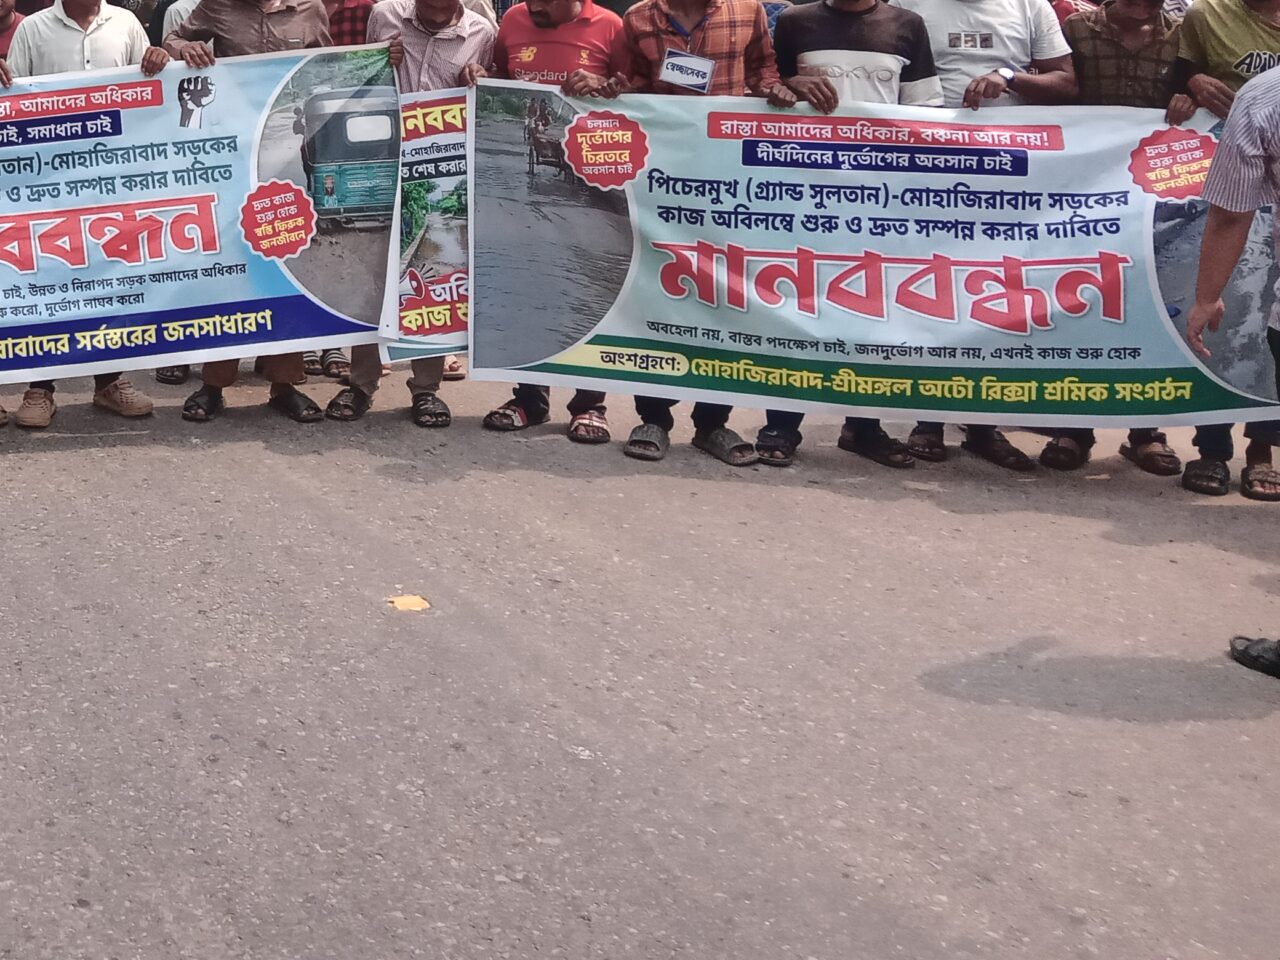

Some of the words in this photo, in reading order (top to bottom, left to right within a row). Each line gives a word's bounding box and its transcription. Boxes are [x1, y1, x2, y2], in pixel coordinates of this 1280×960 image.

[665, 62, 708, 81] স্বেচ্ছাসেবক
[721, 120, 758, 135] রাস্তা
[763, 123, 832, 139] আমাদের
[838, 121, 915, 142] অধিকার,
[922, 129, 970, 144] বঞ্চনা
[974, 131, 1010, 145] আর
[1015, 132, 1049, 147] নয়!
[412, 162, 435, 177] শেষ
[3, 285, 25, 302] চাই,
[28, 282, 56, 298] উন্নত
[60, 283, 68, 293] ও
[72, 275, 113, 293] নিরাপদ
[117, 275, 146, 288] সড়ক
[150, 269, 198, 284] আমাদের
[202, 263, 246, 279] অধিকার
[651, 240, 1132, 335] মানববন্ধন
[12, 304, 42, 319] করো,
[45, 299, 80, 316] দুর্ভোগ
[83, 297, 114, 310] লাঘব
[117, 293, 144, 307] করো
[402, 306, 451, 331] কাজ
[76, 322, 156, 350] সর্বস্তরের
[162, 309, 272, 339] জনসাধারণ
[647, 321, 697, 339] অবহেলা
[702, 328, 723, 343] নয়,
[729, 331, 761, 346] বাস্তব
[767, 337, 819, 351] পদক্ষেপ
[824, 338, 850, 355] চাই,
[855, 342, 923, 360] জনদুর্ভোগ
[927, 347, 956, 358] আর
[961, 347, 986, 361] নয়,
[990, 343, 1033, 359] এখনই
[1037, 345, 1071, 360] কাজ
[1076, 348, 1103, 358] শুরু
[1107, 344, 1140, 359] হোক
[919, 377, 974, 401] অটো
[981, 376, 1037, 402] রিক্সা
[1044, 376, 1108, 401] শ্রমিক
[1115, 378, 1192, 401] সংগঠন
